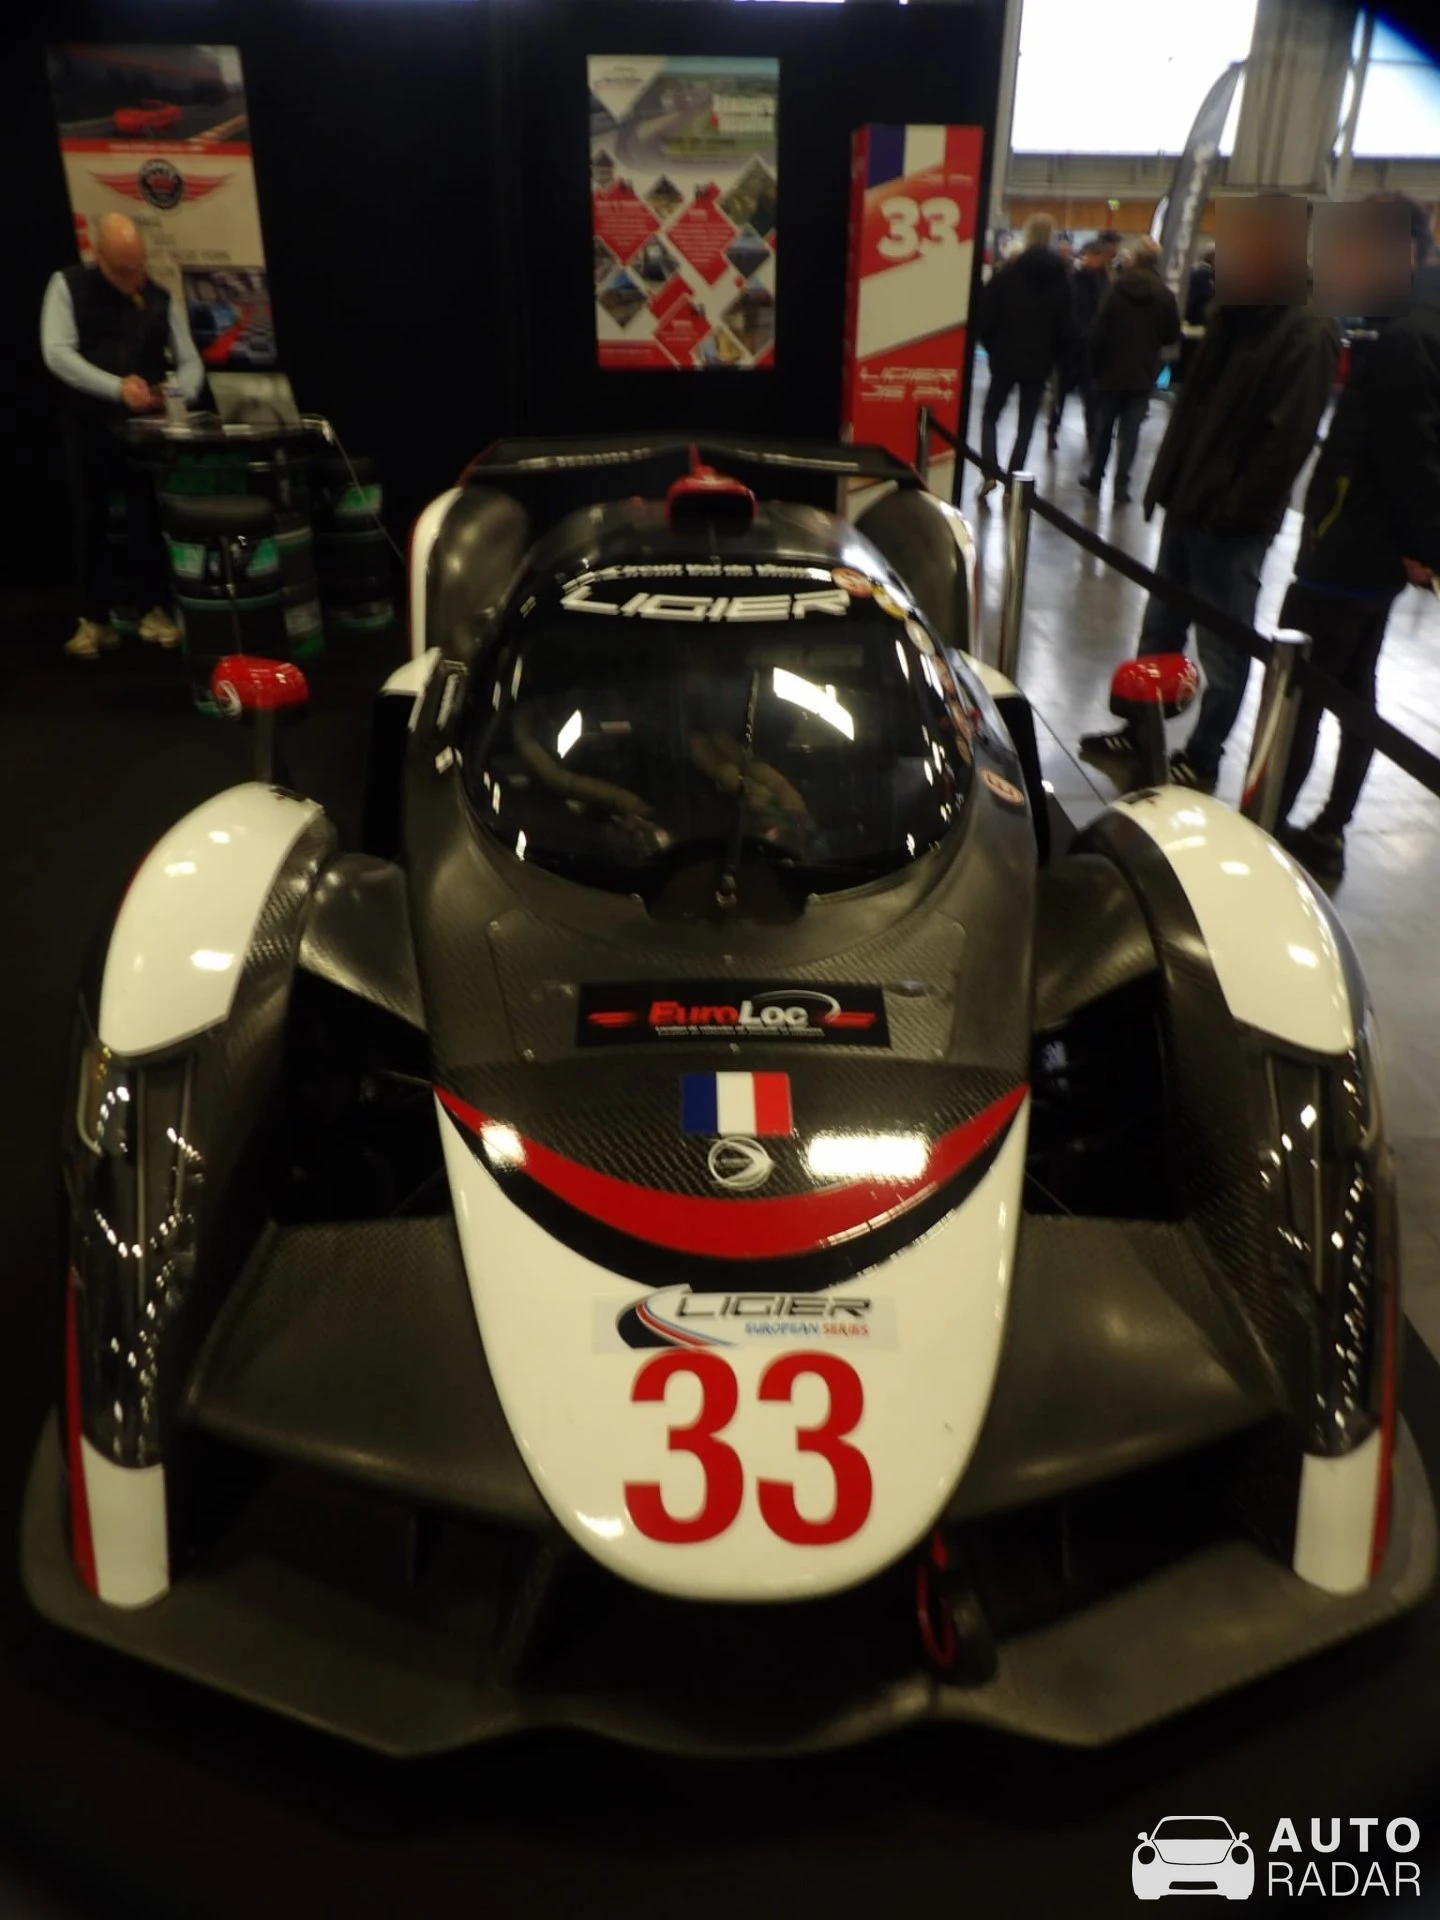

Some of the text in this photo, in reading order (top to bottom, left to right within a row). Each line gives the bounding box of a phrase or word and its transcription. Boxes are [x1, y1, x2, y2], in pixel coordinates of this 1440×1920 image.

[876, 196, 961, 260] 33
[561, 587, 850, 622] LIGIER
[649, 1000, 809, 1028] EuroLoc
[675, 1293, 872, 1318] LIGIER
[745, 1322, 870, 1336] EUROPEAN SERIES
[623, 1347, 873, 1545] 33
